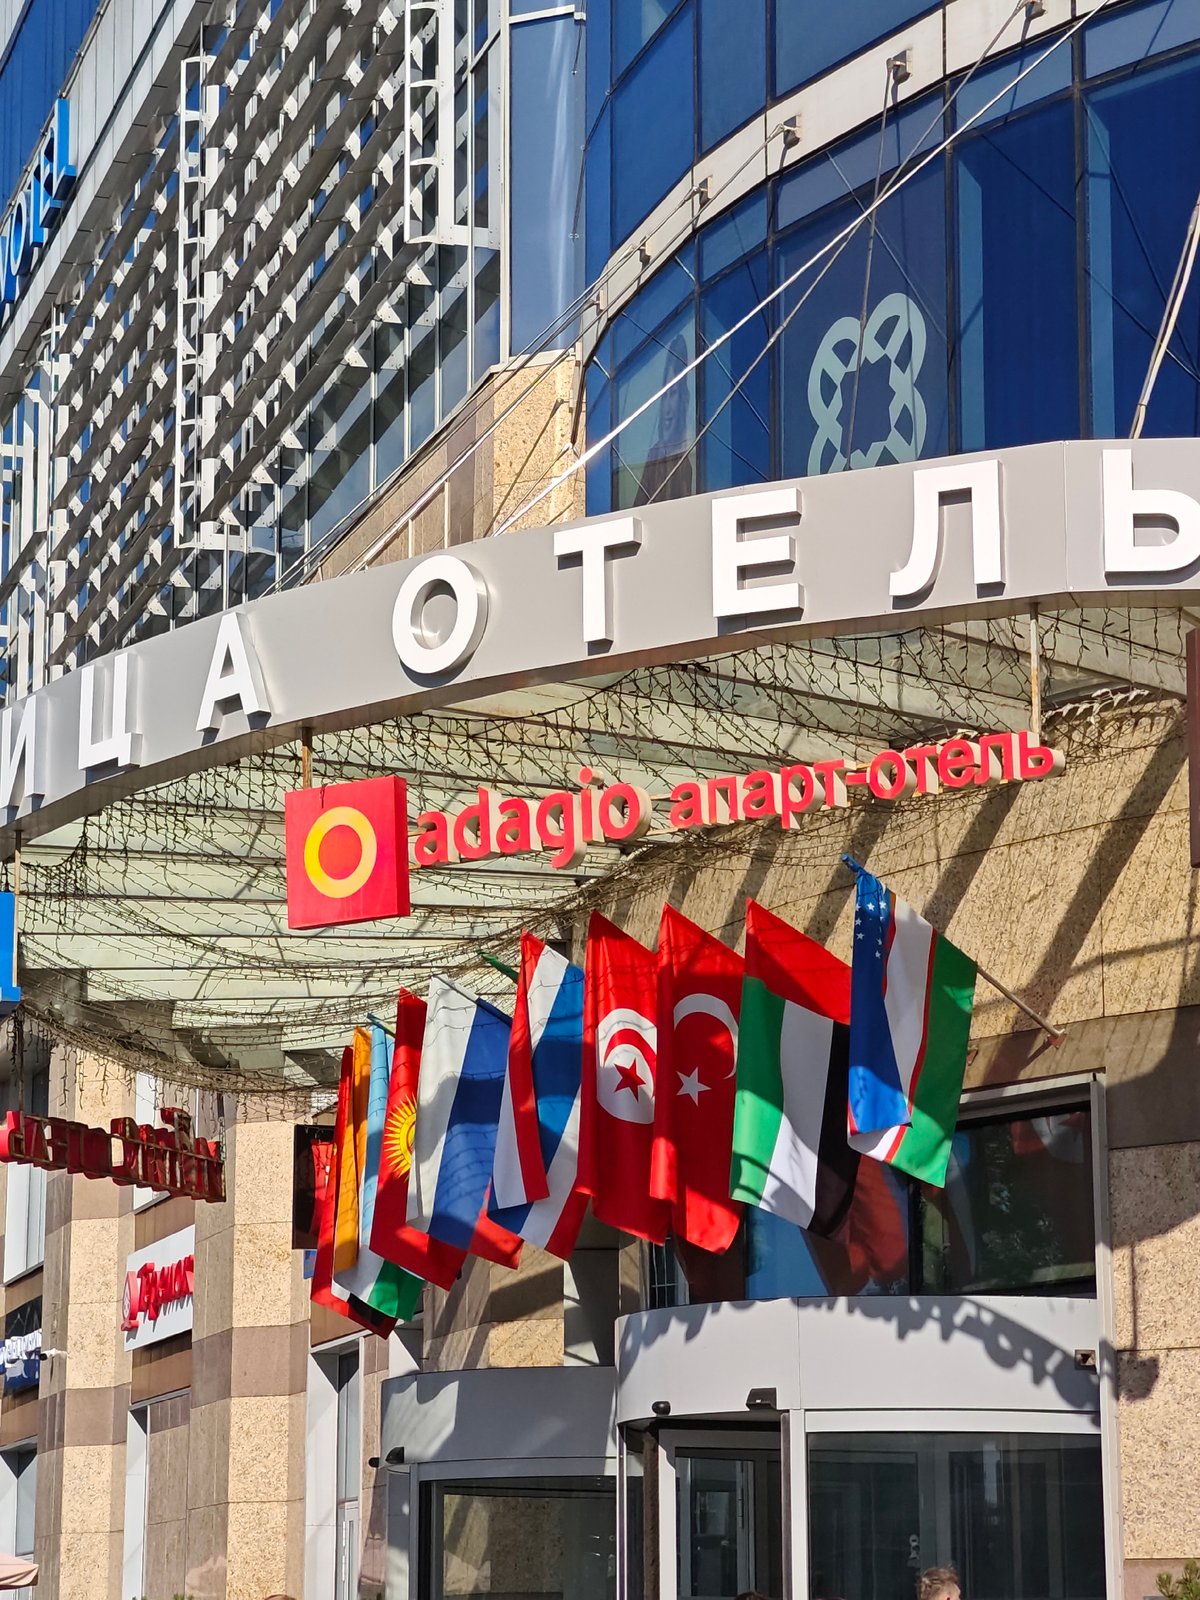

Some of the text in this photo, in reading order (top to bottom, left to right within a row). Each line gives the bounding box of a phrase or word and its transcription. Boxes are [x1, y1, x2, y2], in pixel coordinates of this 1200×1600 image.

[392, 447, 1200, 676] ОТЕЛЬ
[415, 730, 1064, 870] adagio апарт-отель
